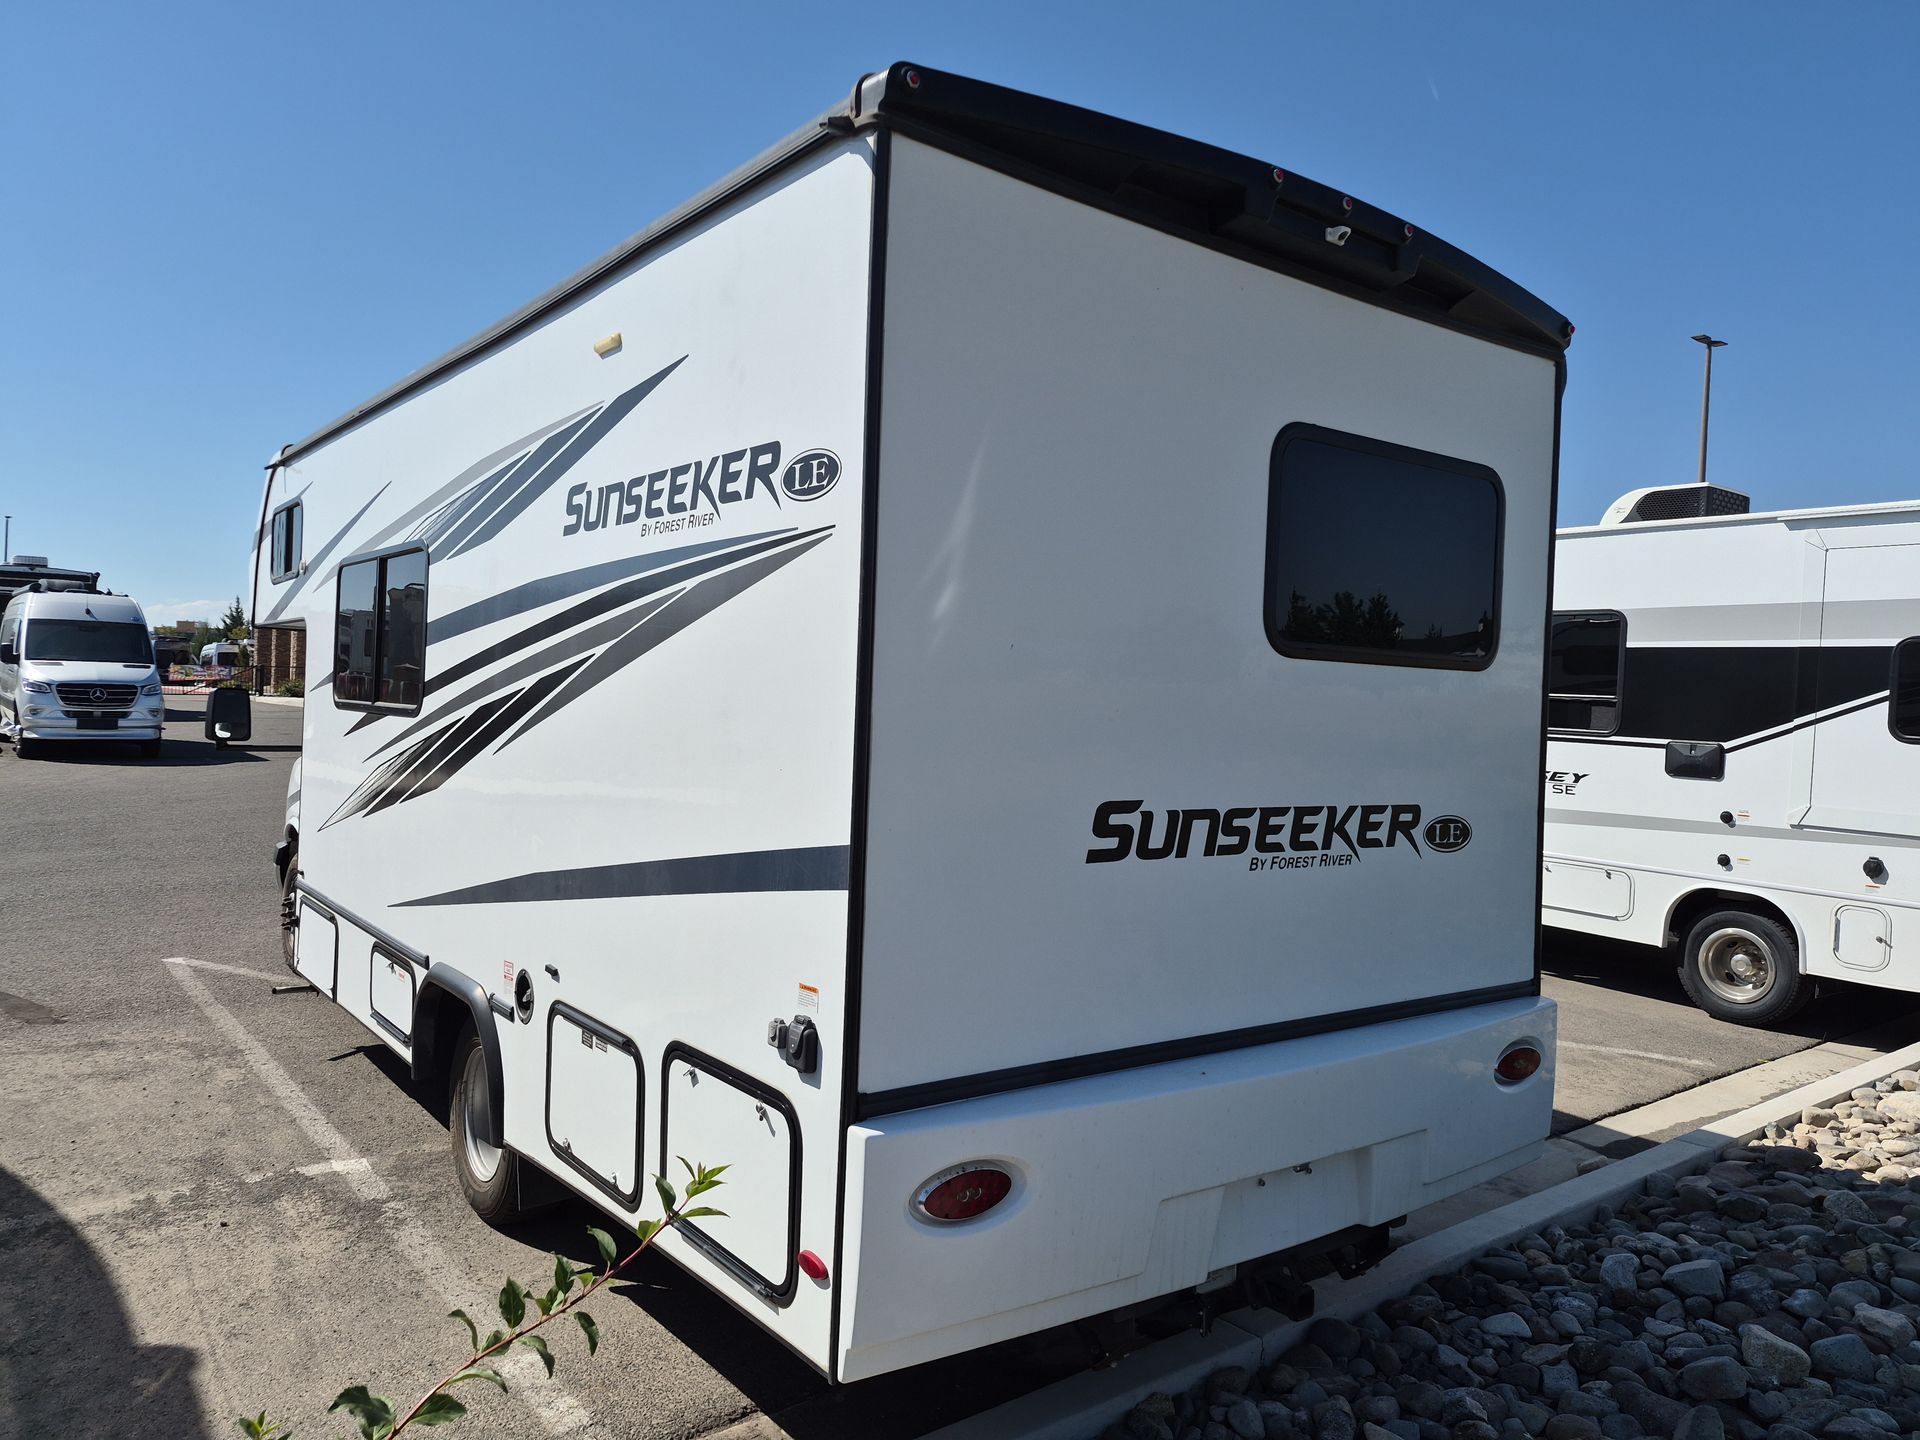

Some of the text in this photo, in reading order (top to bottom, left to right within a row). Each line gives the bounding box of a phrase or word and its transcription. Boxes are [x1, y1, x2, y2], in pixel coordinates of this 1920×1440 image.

[792, 457, 829, 491] LE
[641, 512, 714, 537] BY FOREST RIVER
[1552, 784, 1576, 796] SE
[1433, 823, 1463, 844] LE
[1249, 853, 1353, 871] BY FOREST RIVER
